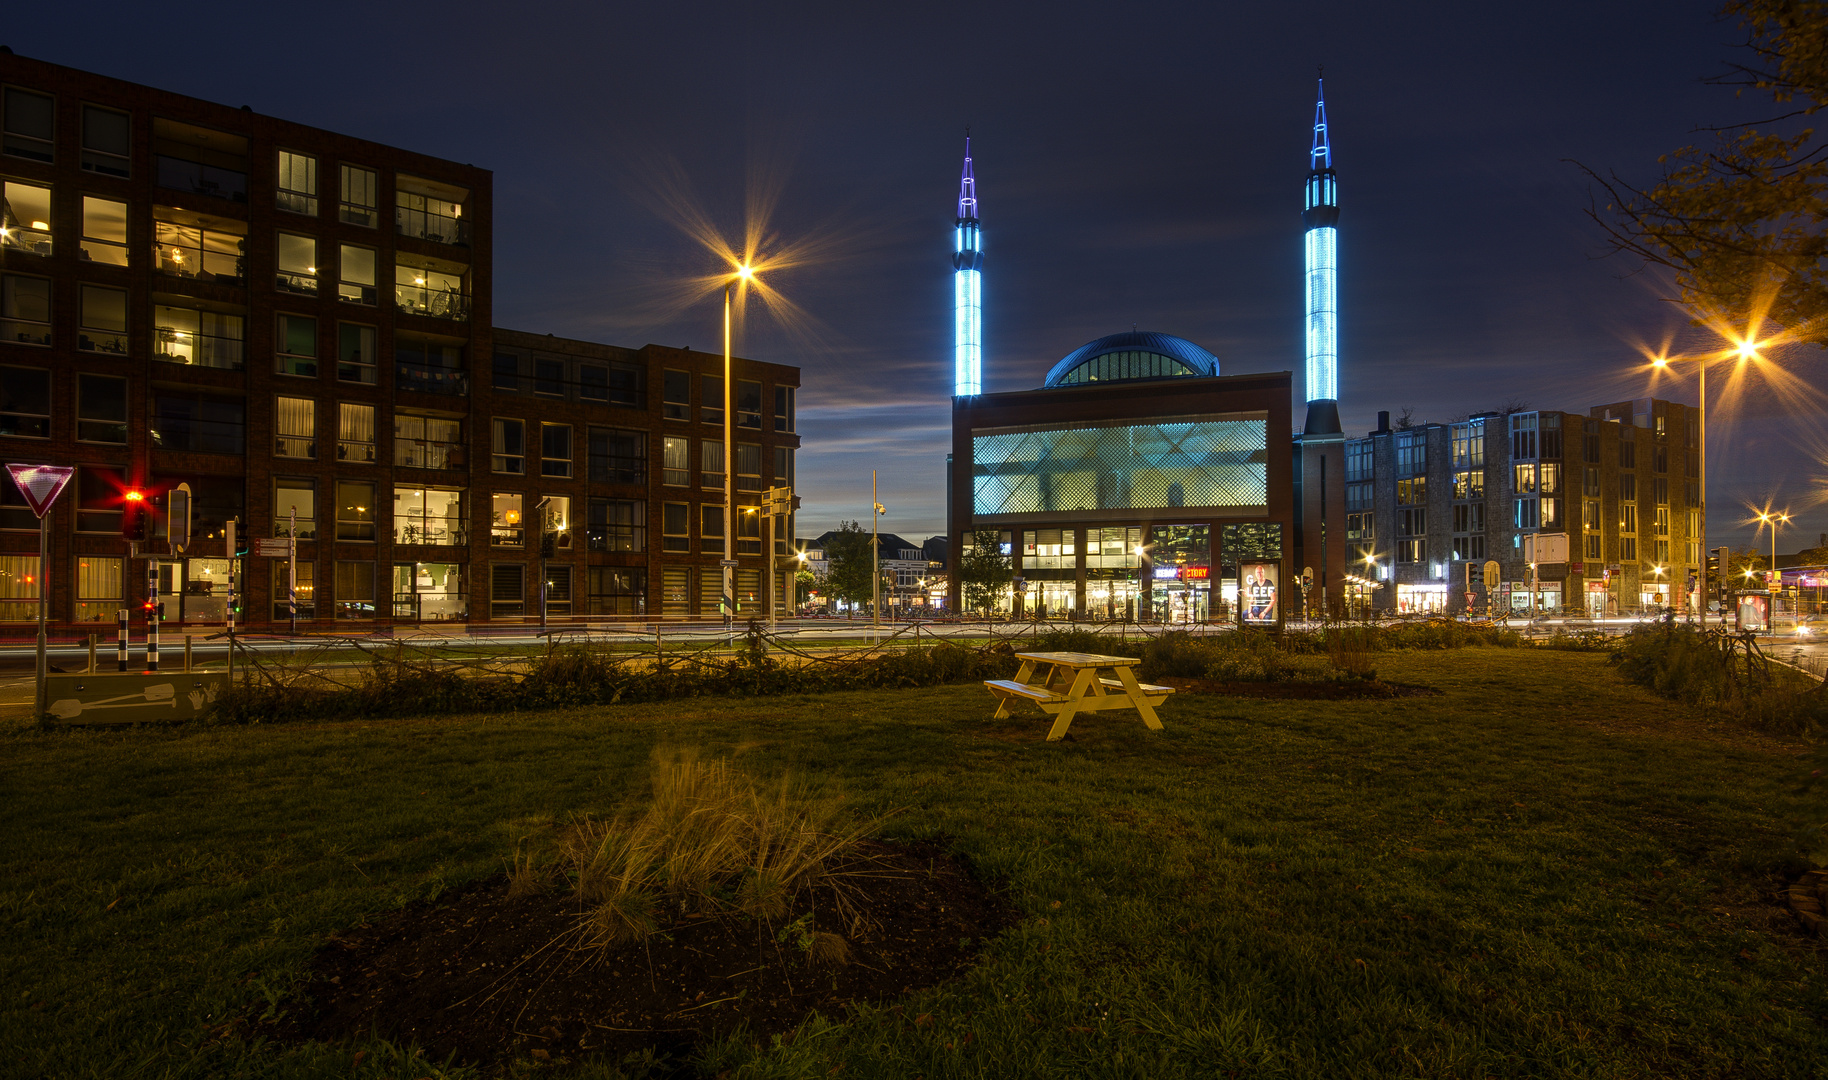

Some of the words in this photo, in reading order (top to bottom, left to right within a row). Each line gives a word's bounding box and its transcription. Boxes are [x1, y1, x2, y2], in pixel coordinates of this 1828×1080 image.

[1178, 569, 1207, 578] FCTORY
[1246, 574, 1254, 585] G
[1246, 586, 1275, 597] LEEF
